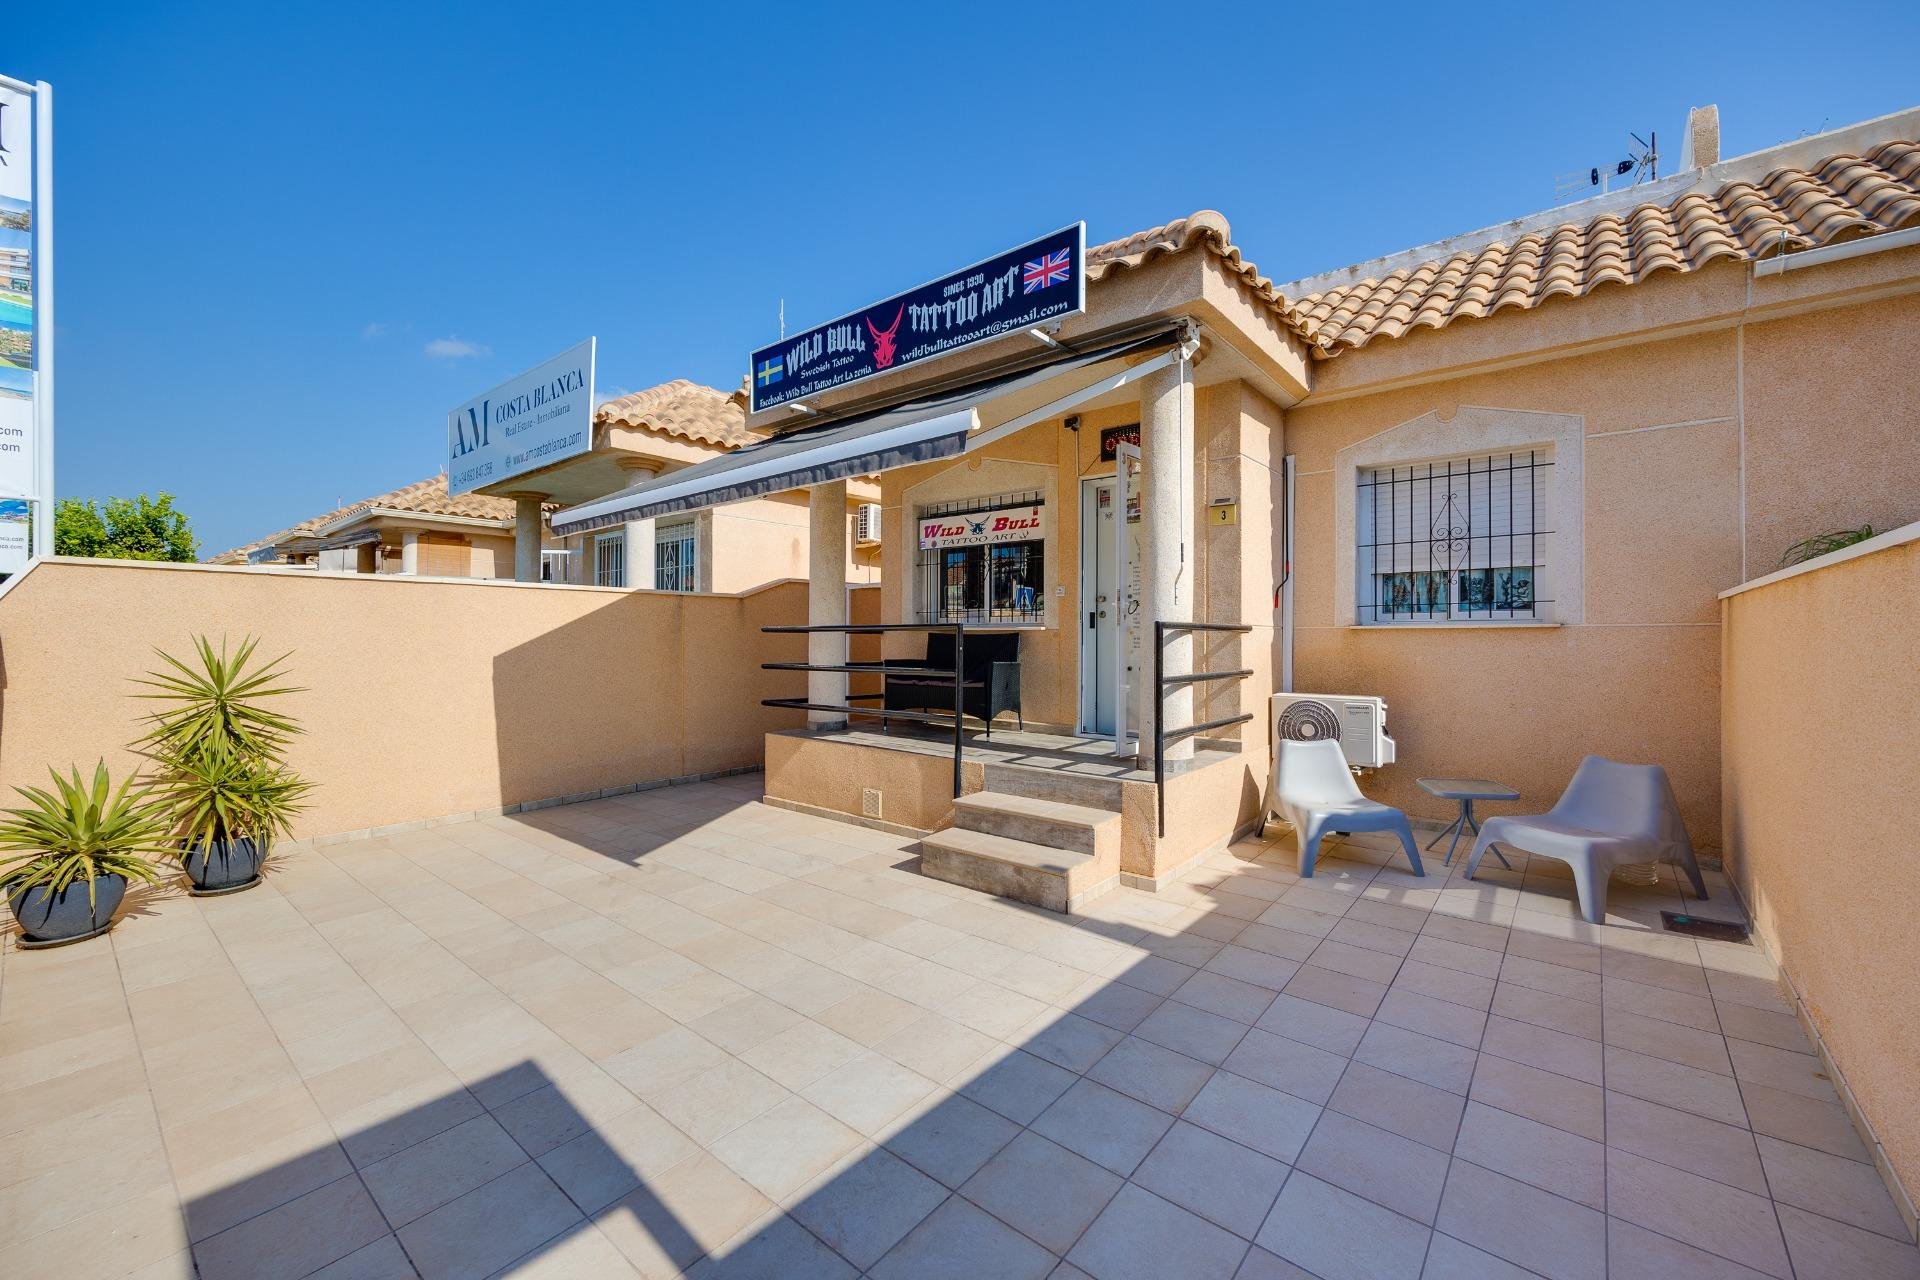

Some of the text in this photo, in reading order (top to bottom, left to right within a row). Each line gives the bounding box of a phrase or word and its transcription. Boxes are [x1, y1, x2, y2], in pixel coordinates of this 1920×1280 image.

[908, 264, 1020, 333] TATTOO ART
[943, 281, 965, 298] SINCE
[901, 301, 1069, 362] wildbulltattooart@gmail.com
[786, 323, 866, 377] WILD BULL
[800, 355, 854, 379] Swedish Tattoo
[800, 382, 813, 395] Bull
[814, 379, 832, 391] Tattoo
[832, 374, 844, 385] Art
[844, 370, 854, 380] La
[496, 368, 584, 424] COSTA BLANCA
[451, 400, 491, 459] AM
[505, 424, 516, 438] Real
[1221, 510, 1227, 520] 3
[923, 517, 1040, 538] WILD BULL
[941, 532, 1016, 546] TATTOO ART
